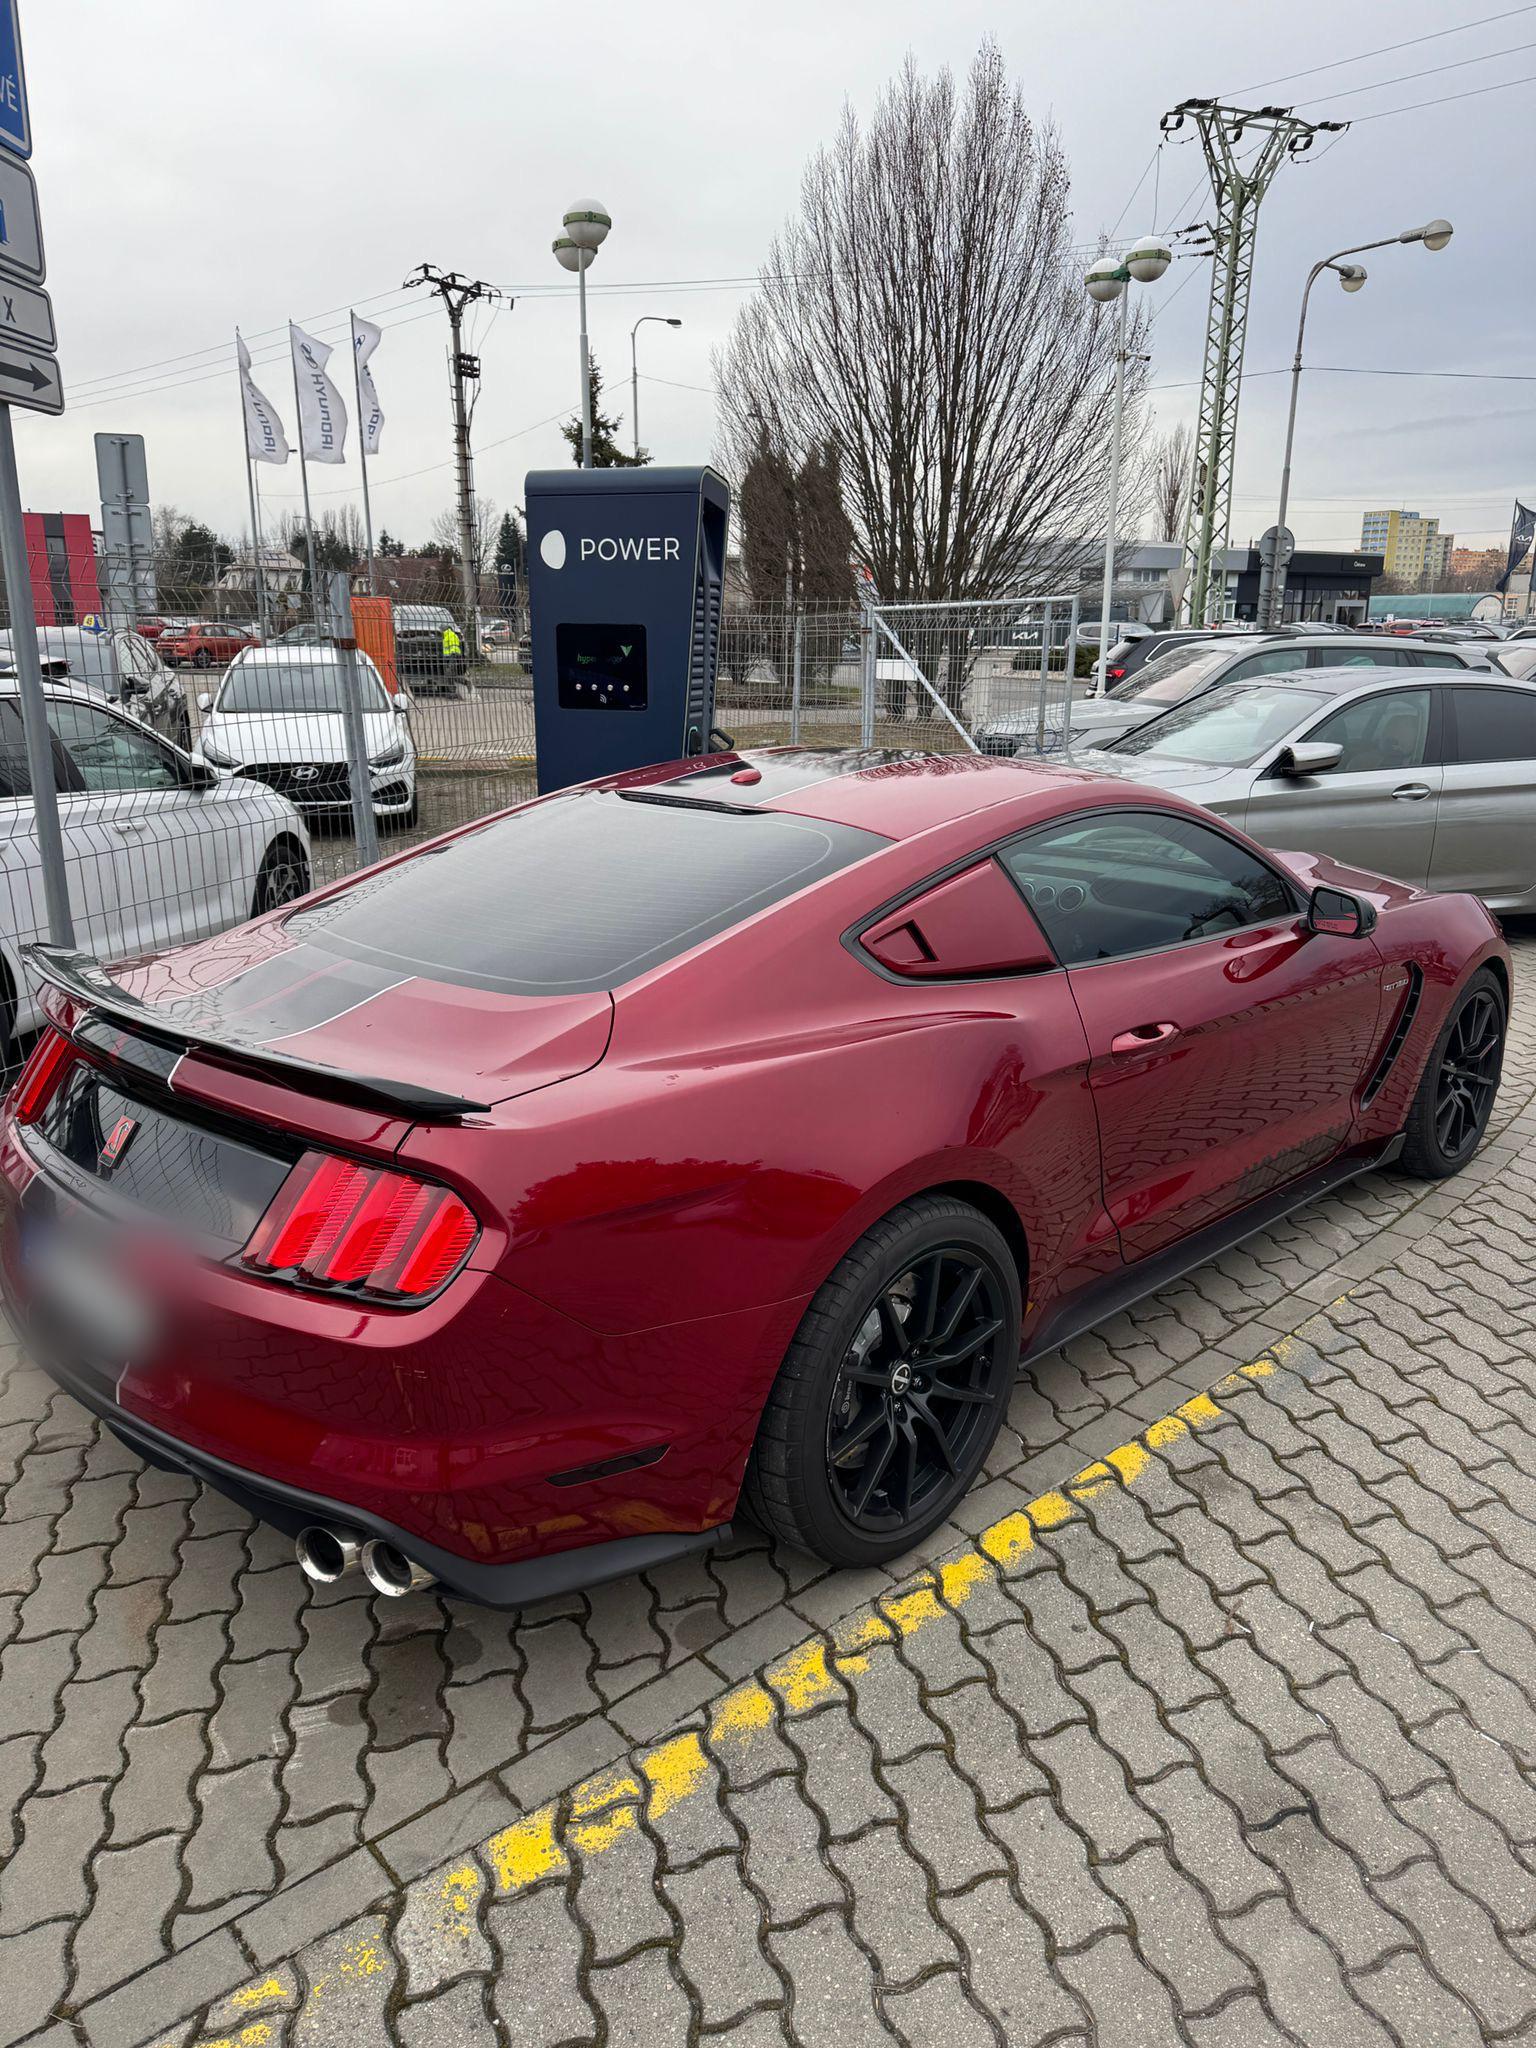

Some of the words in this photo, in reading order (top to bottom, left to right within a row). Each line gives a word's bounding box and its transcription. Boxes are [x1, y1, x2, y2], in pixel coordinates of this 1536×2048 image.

[253, 402, 276, 452] UNDAI
[311, 373, 333, 450] HYUNDAI
[581, 537, 680, 560] POWER
